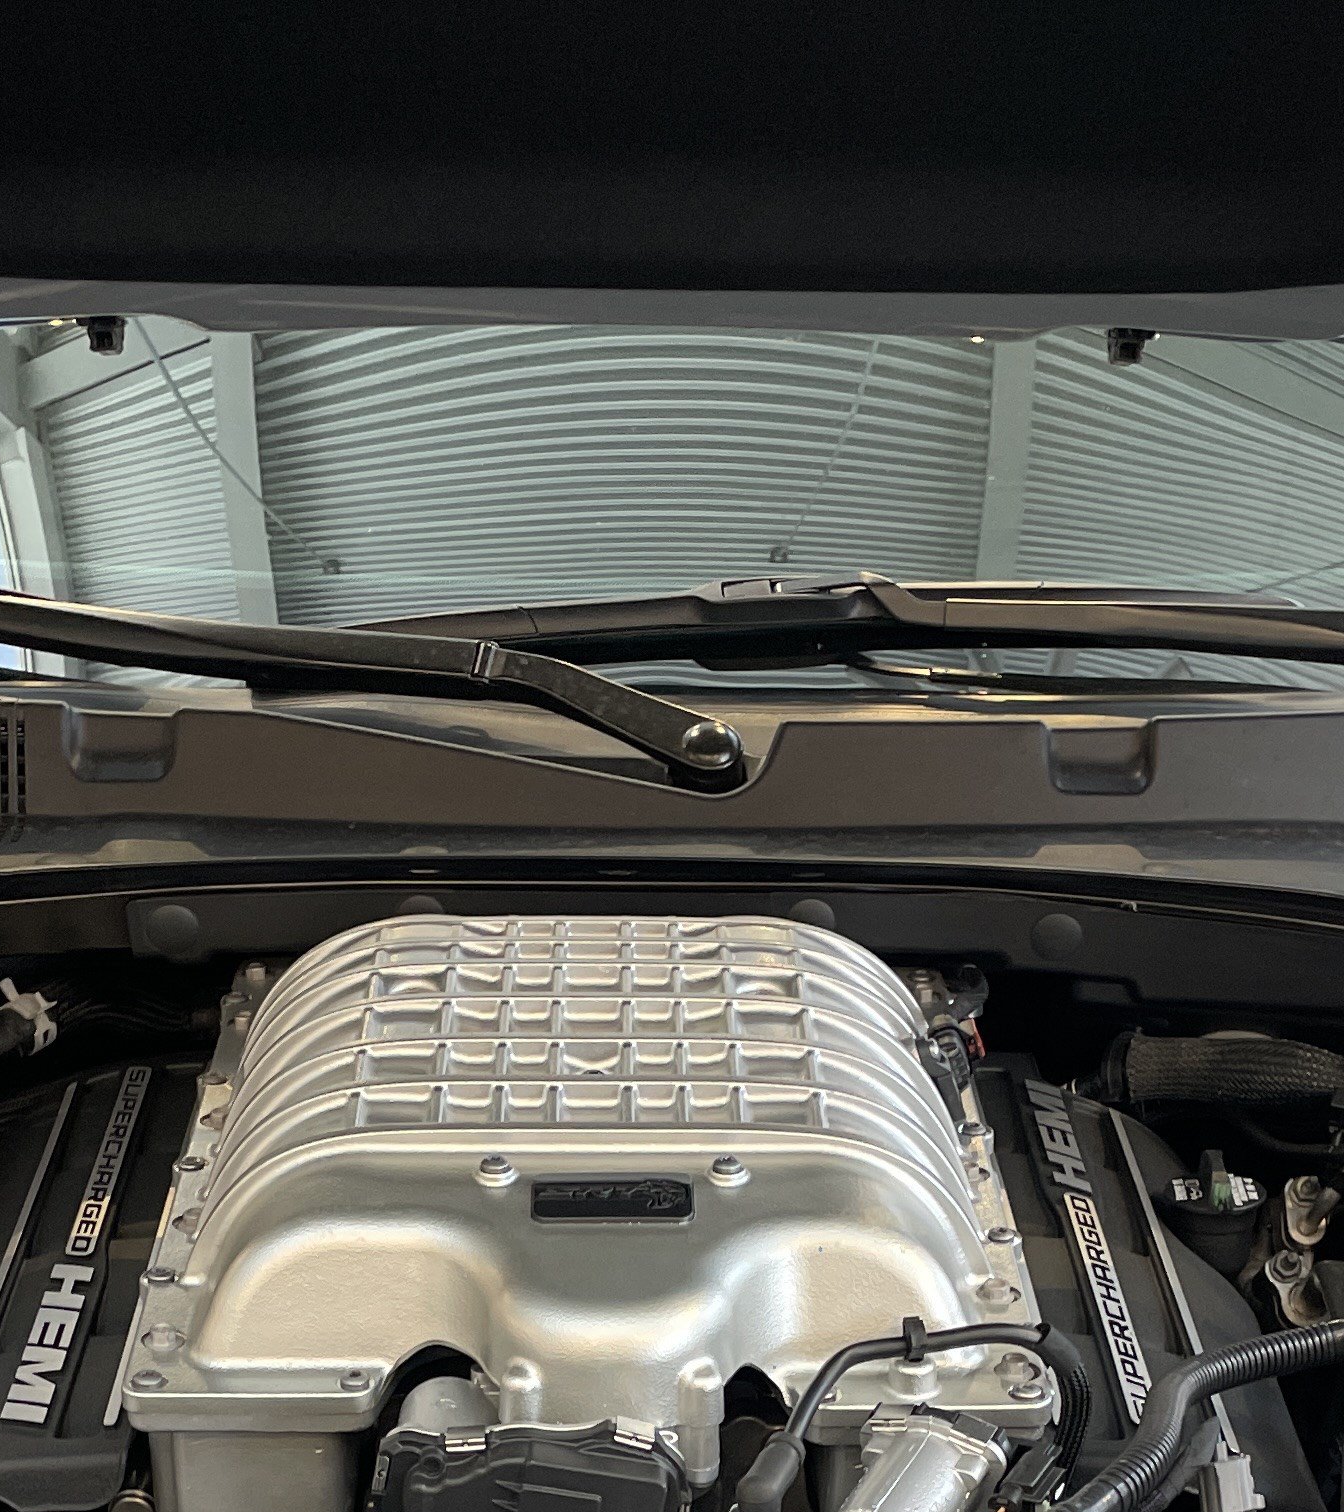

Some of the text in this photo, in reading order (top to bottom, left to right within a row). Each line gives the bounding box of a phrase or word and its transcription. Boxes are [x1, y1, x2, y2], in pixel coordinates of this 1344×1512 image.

[67, 1068, 151, 1256] SUPERCHARGED
[1025, 1080, 1092, 1195] HEMI
[0, 1263, 95, 1424] HEMI
